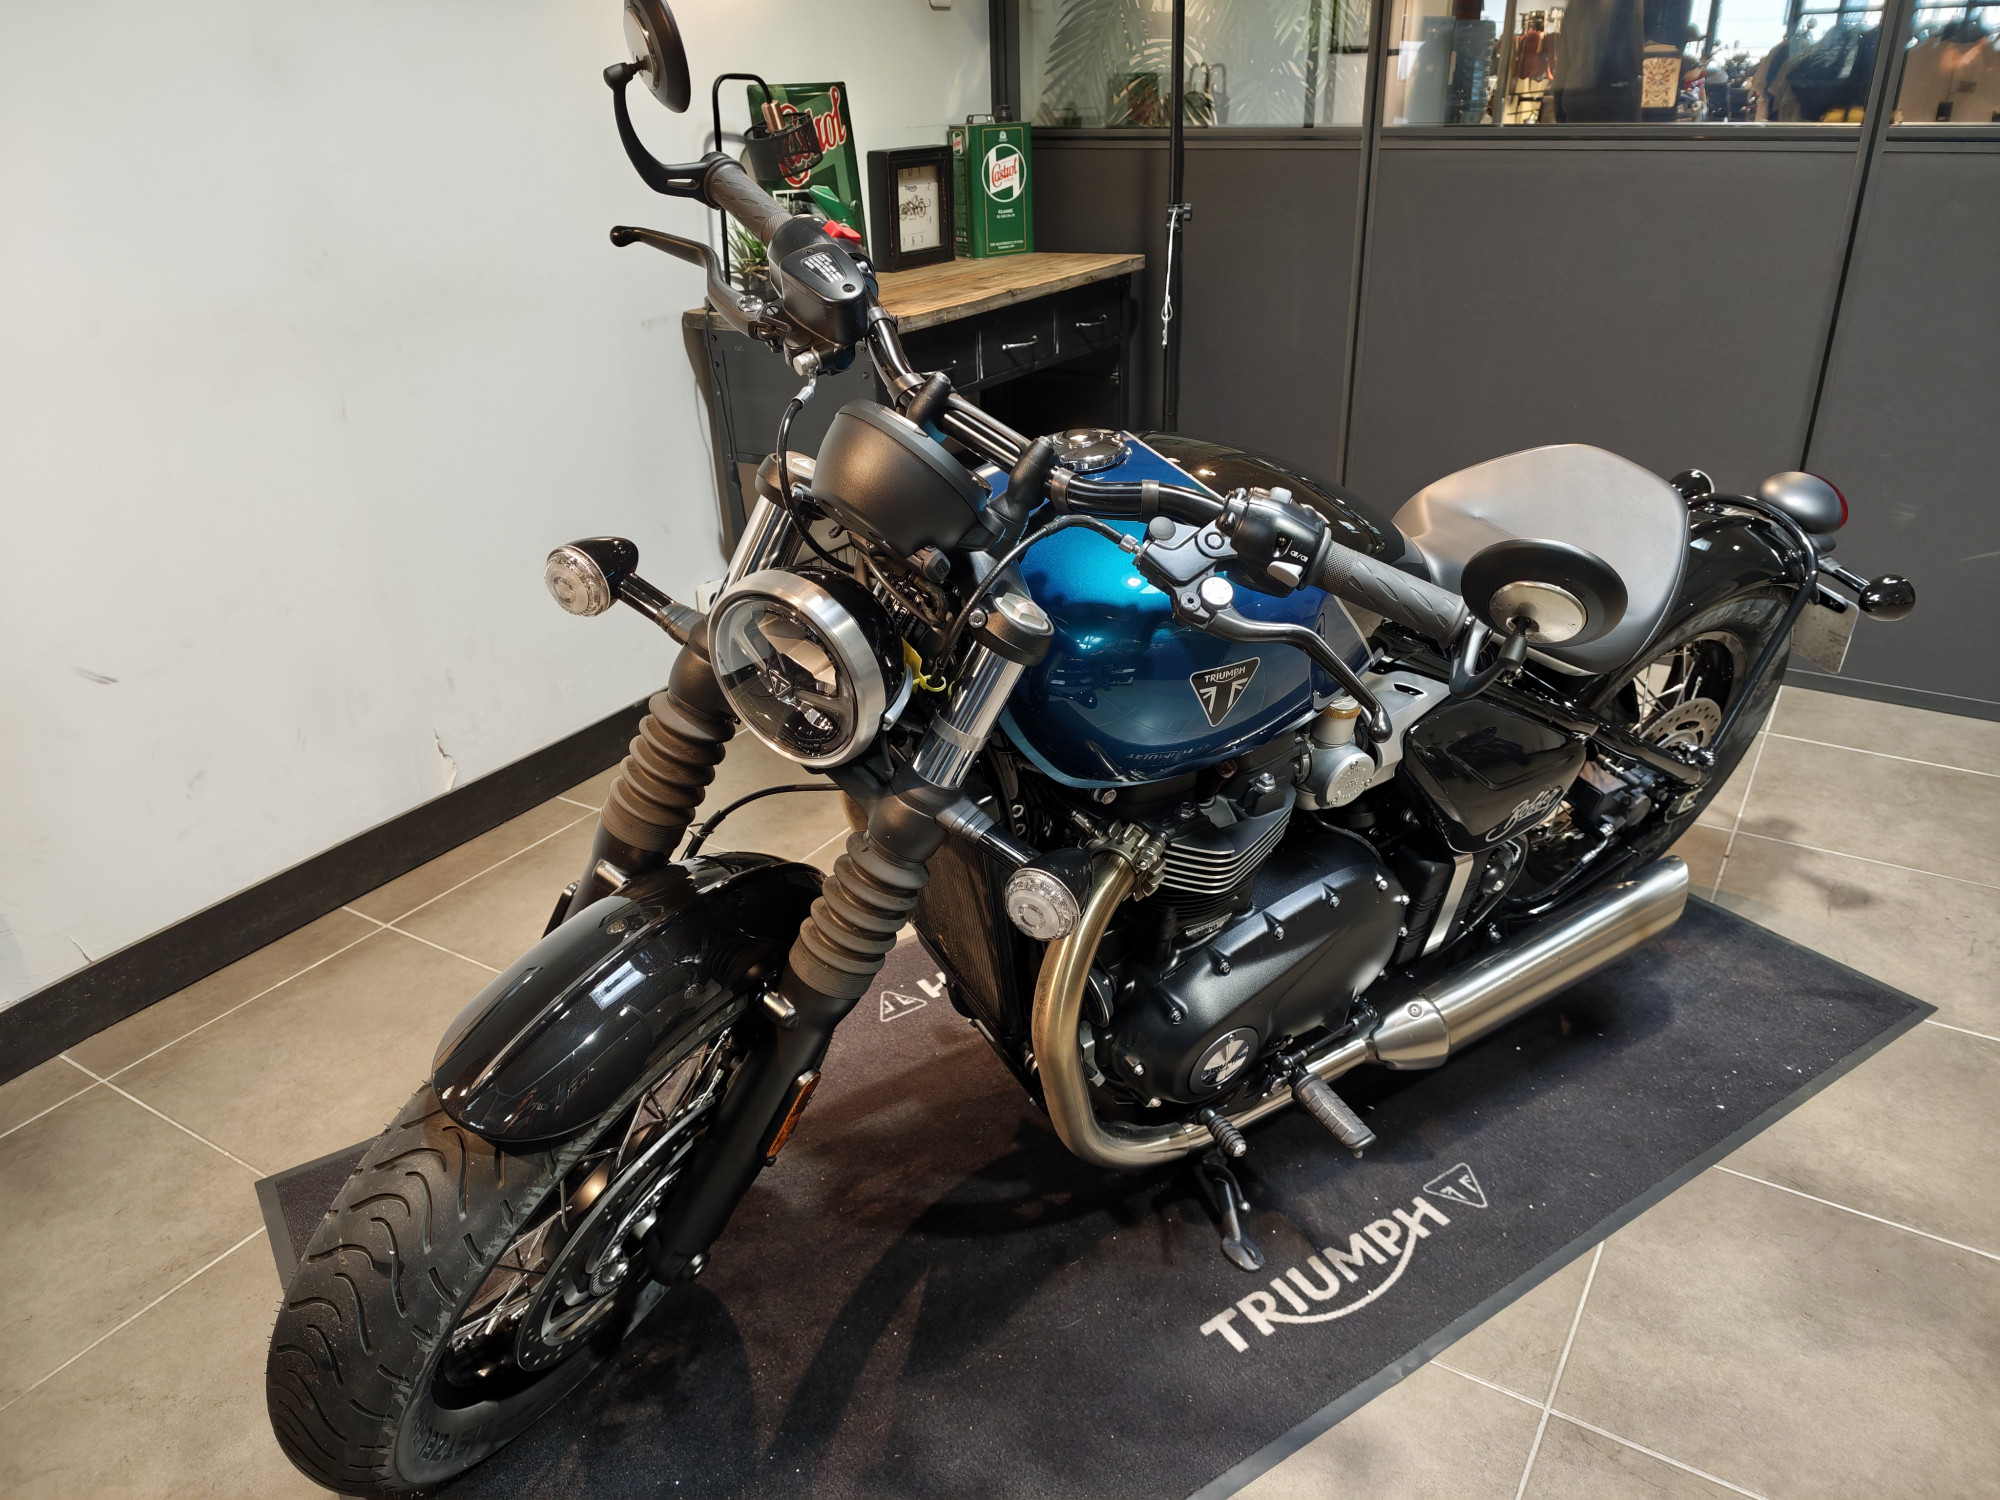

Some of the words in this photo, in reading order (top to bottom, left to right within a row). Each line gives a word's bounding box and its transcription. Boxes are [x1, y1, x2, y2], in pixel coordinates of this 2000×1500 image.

[992, 157, 1018, 188] Castrol
[1204, 665, 1246, 683] TRIUMPH
[1200, 1196, 1450, 1353] TRIUMPH
